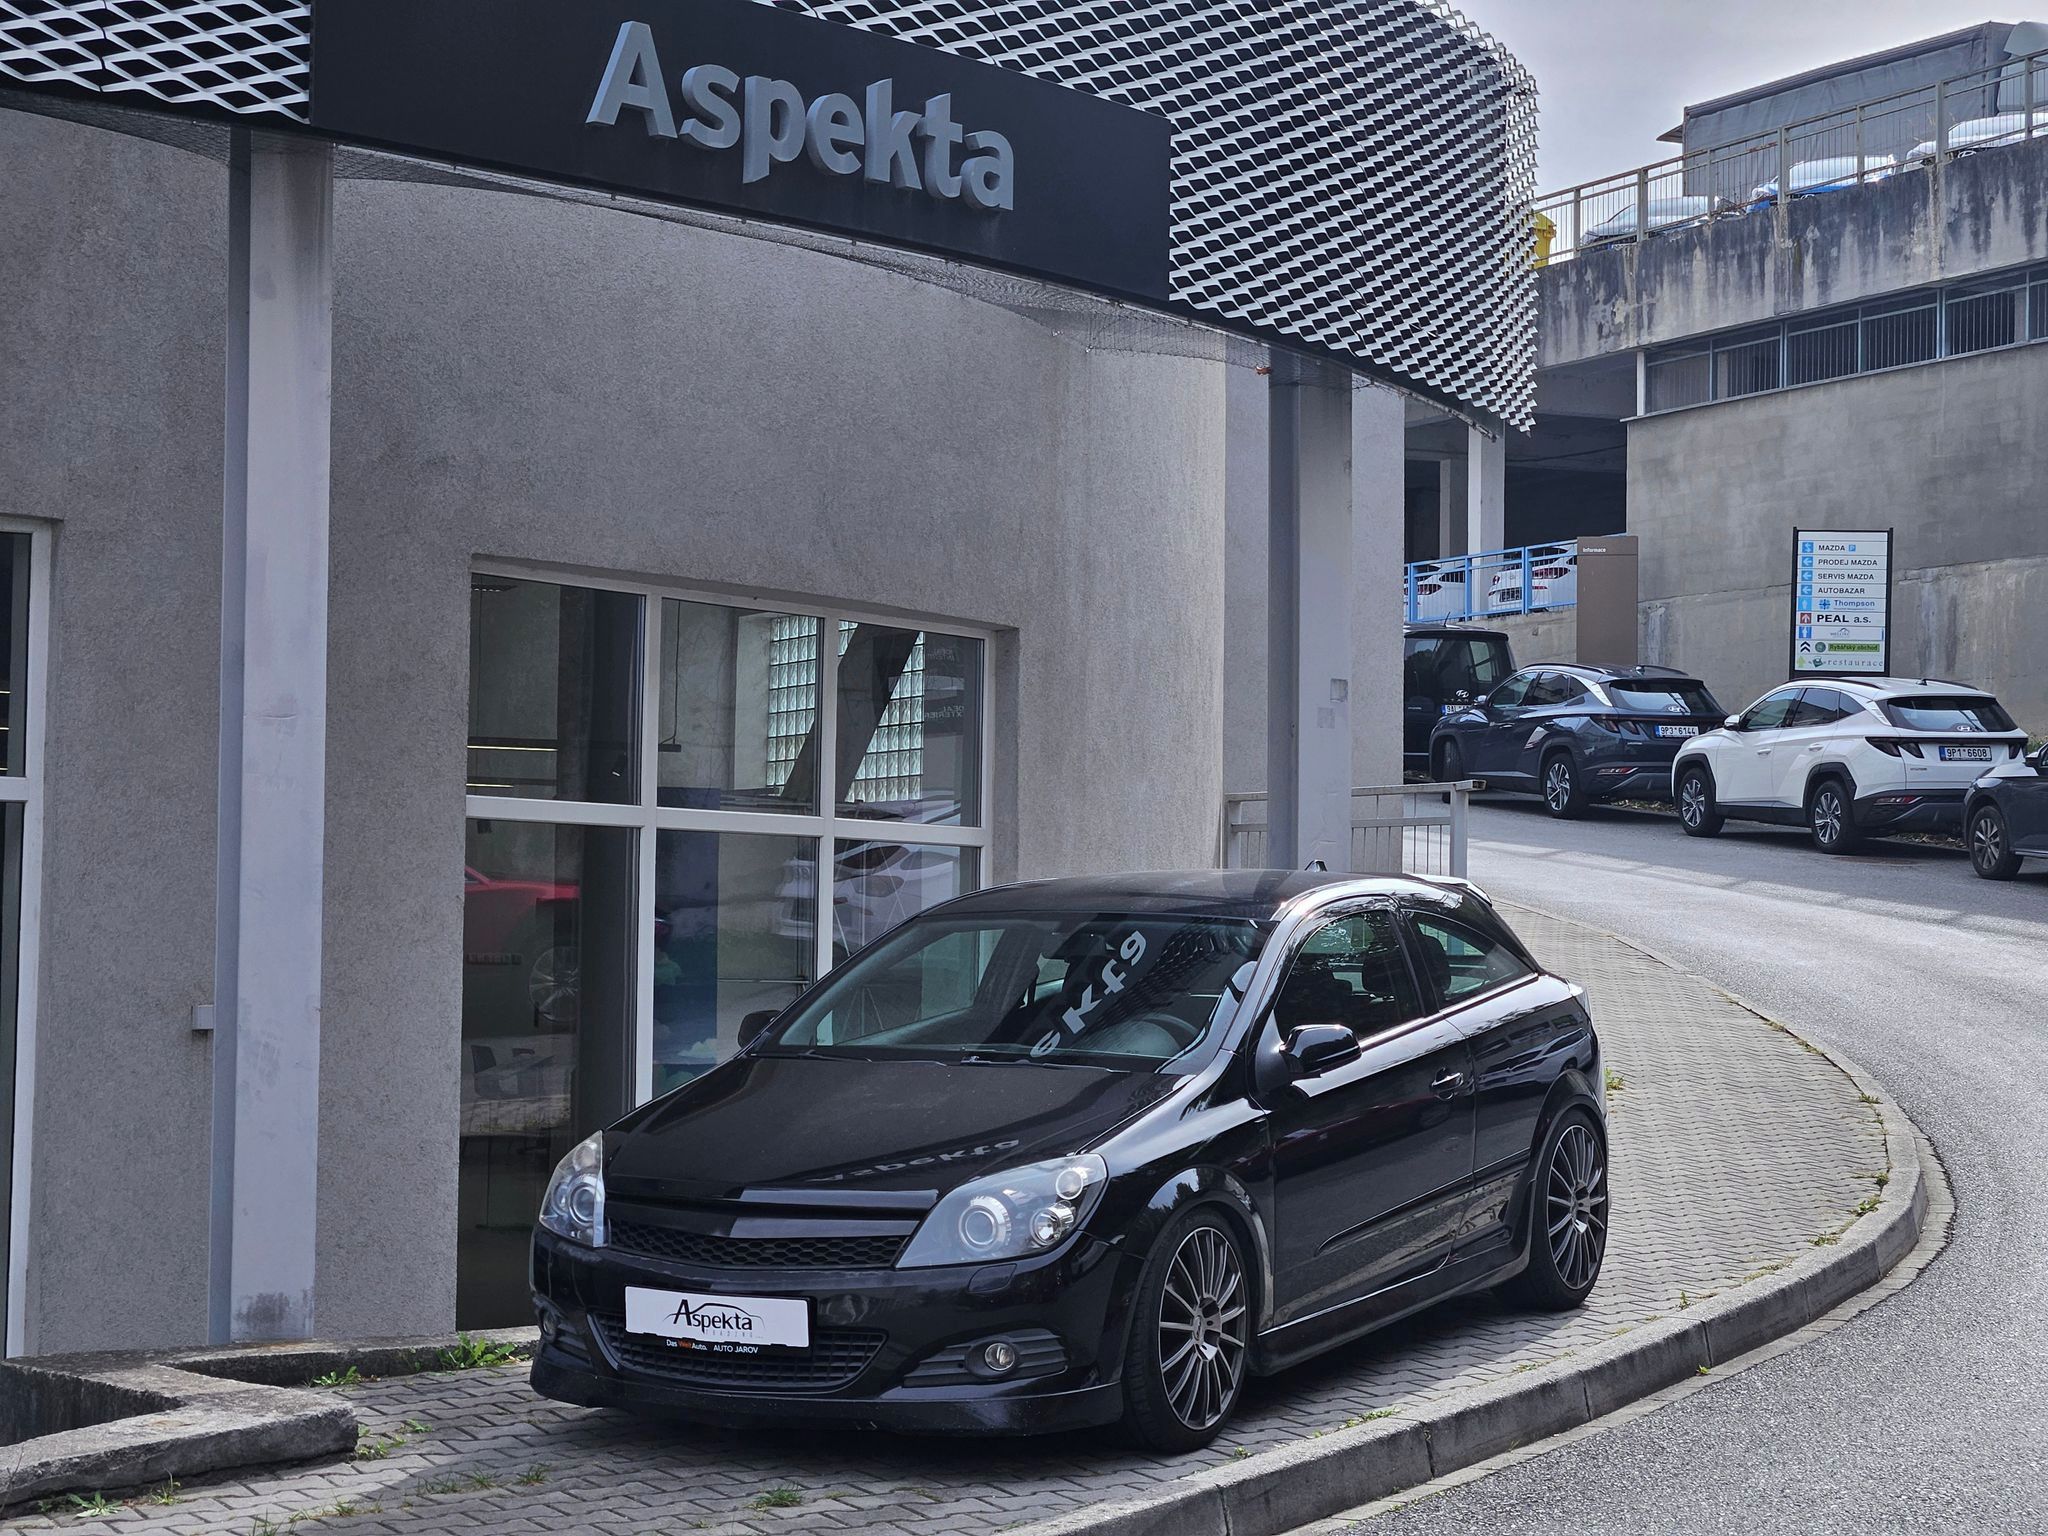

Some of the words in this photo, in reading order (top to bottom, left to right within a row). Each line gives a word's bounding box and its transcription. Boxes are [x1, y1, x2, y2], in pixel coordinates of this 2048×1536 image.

[585, 20, 1014, 210] Aspekta
[1817, 614, 1850, 623] PEAL
[1828, 659, 1883, 667] restaurace
[1660, 726, 1674, 734] 9P3
[1946, 748, 1962, 757] 9P1
[1967, 748, 1987, 757] 6608
[672, 1299, 753, 1334] Aspekta
[666, 1339, 678, 1347] Das
[713, 1344, 734, 1353] AUTO
[735, 1345, 759, 1354] JAROV
